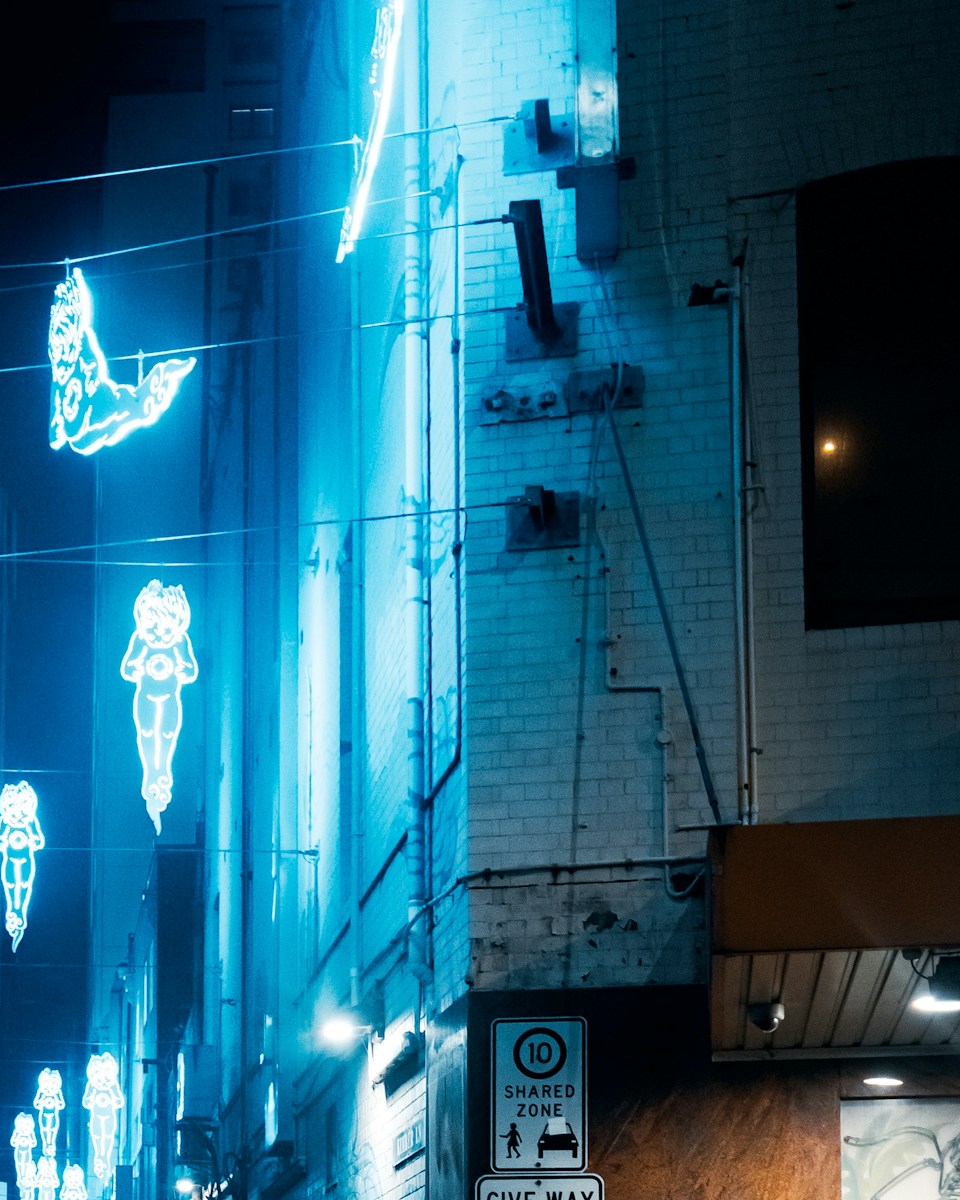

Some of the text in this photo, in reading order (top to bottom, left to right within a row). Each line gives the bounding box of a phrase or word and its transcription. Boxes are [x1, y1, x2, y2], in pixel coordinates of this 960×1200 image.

[528, 1042, 553, 1063] 10
[504, 1085, 575, 1099] SHARED
[517, 1103, 563, 1117] ZONE
